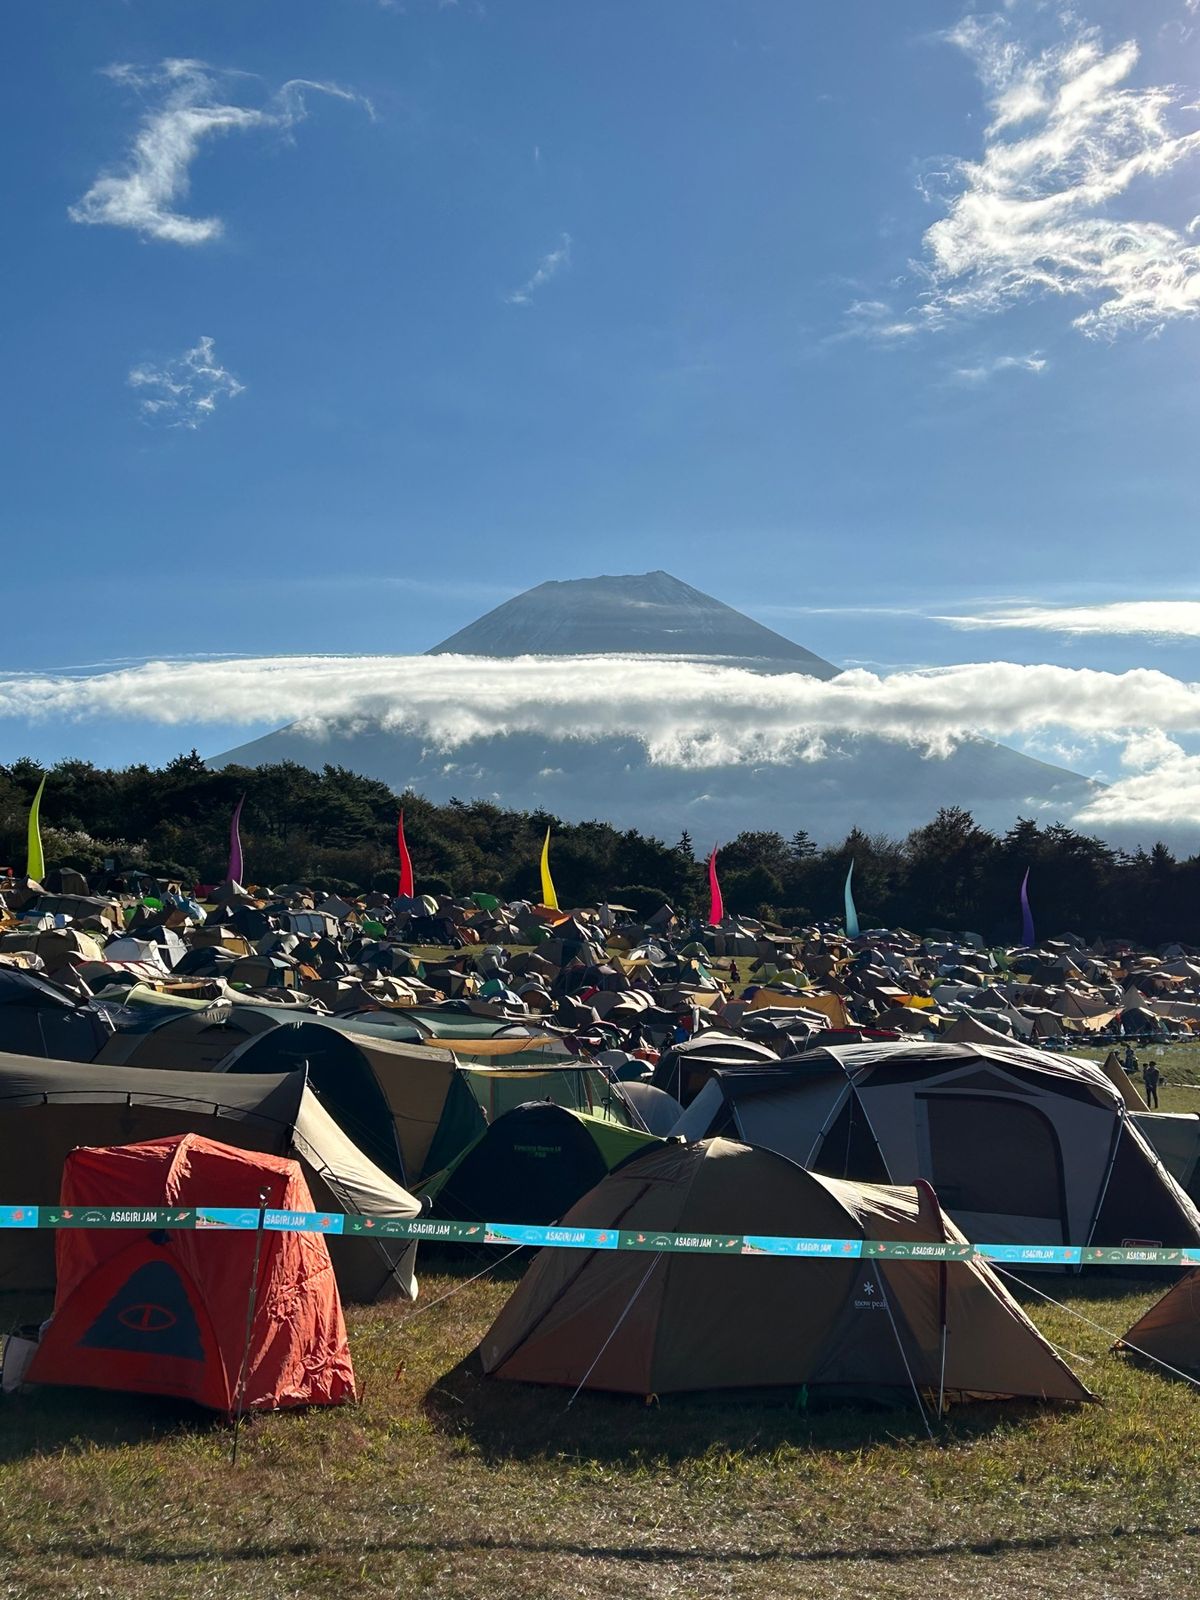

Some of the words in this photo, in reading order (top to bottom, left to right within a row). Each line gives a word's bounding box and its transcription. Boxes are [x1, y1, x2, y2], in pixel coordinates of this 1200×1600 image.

[110, 1211, 141, 1222] ASAGIRI
[141, 1212, 157, 1223] JAM
[264, 1213, 290, 1226] SAGIRI
[290, 1216, 306, 1226] JAM
[408, 1223, 435, 1235] ASAGIRI
[435, 1225, 450, 1235] JAM
[545, 1231, 572, 1242] ASAGIRI
[572, 1233, 585, 1243] JAM
[674, 1237, 699, 1247] ASAGIRI
[699, 1238, 712, 1248] JAM
[912, 1246, 934, 1256] ASAGIRI
[934, 1247, 946, 1256] JAM
